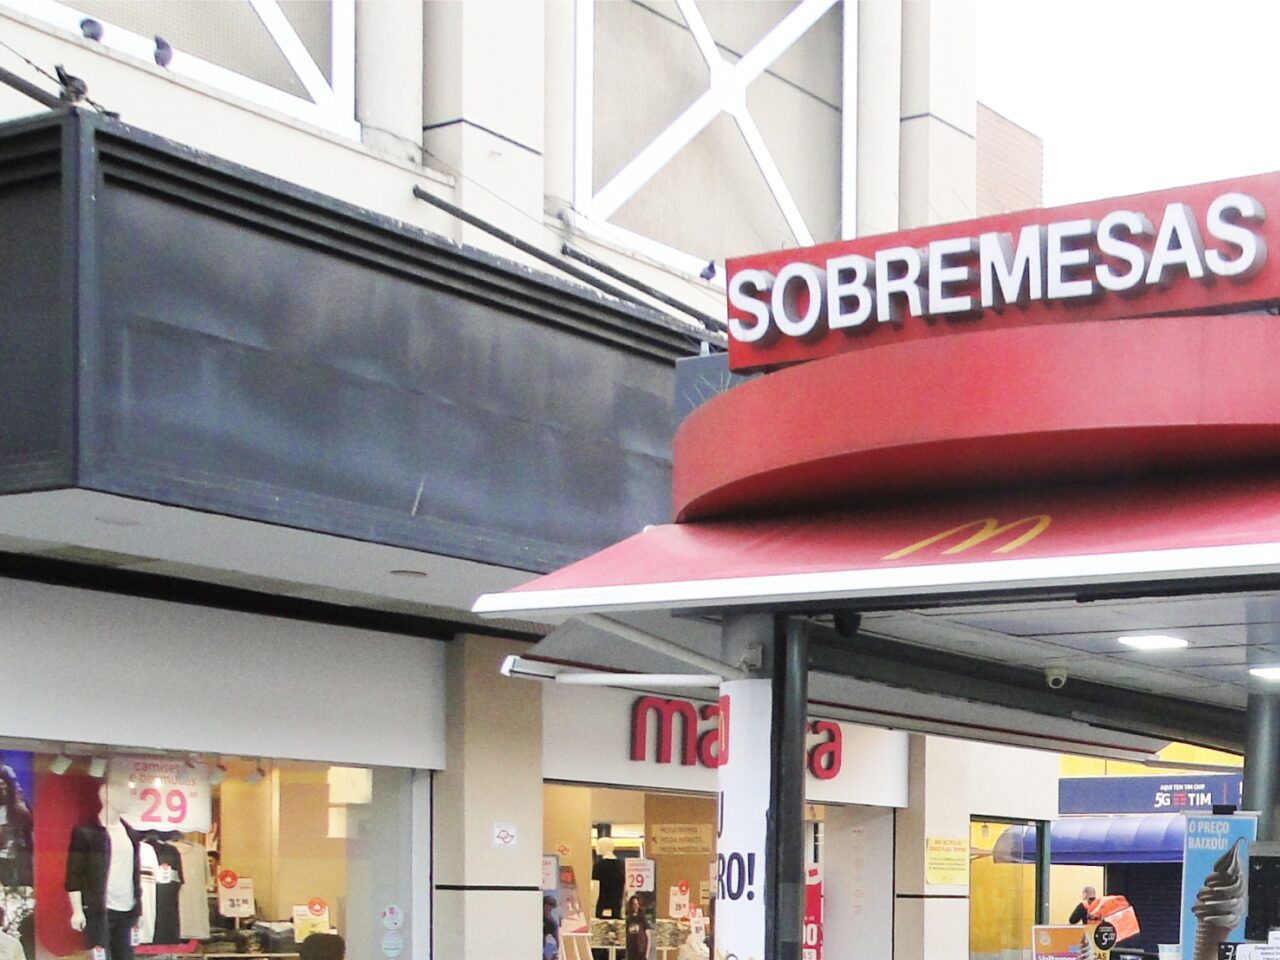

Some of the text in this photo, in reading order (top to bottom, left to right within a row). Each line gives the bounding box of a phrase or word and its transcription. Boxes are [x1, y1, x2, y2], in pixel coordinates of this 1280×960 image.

[728, 191, 1266, 344] SOBREMESAS
[139, 787, 188, 824] 29
[1153, 792, 1212, 808] 5G TIM
[1188, 821, 1230, 838] O PREÇO
[1188, 836, 1228, 850] BAIXOU!
[717, 851, 756, 901] RO!
